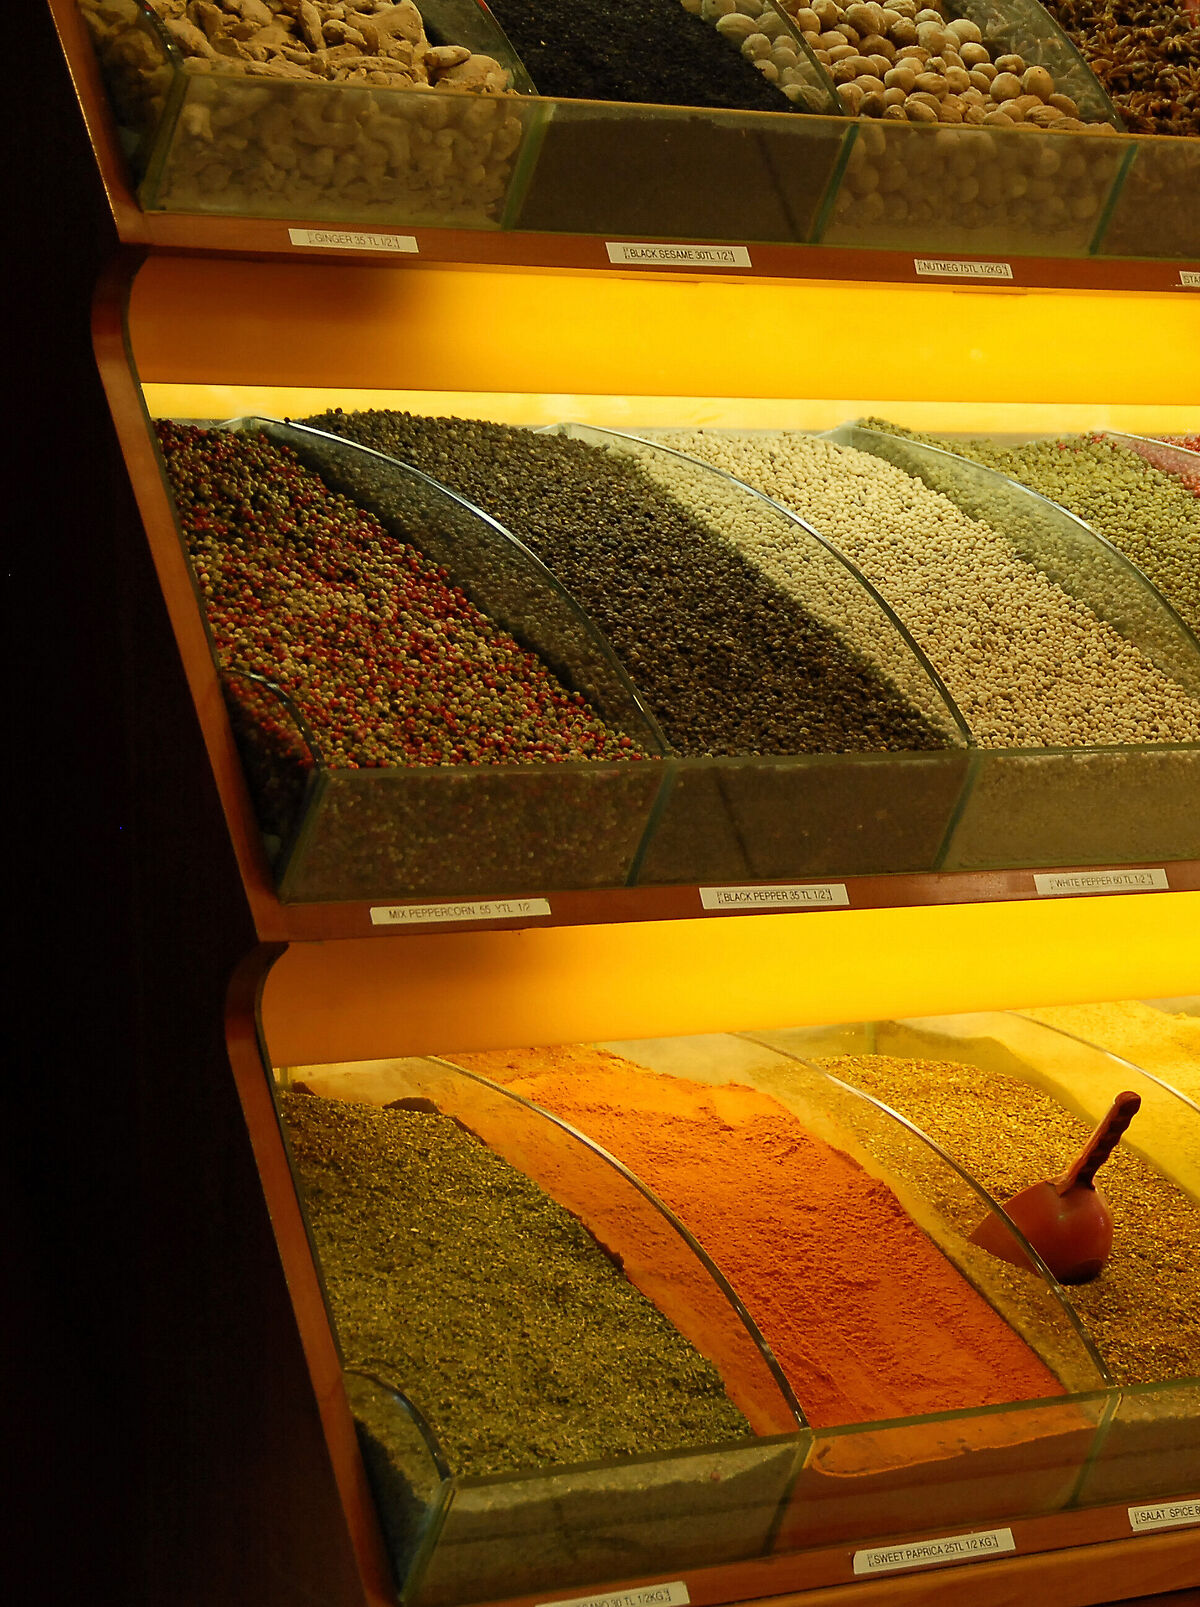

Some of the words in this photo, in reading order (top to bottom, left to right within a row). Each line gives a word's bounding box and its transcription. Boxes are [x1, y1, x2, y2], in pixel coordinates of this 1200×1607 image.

[314, 233, 352, 244] GINGER
[355, 236, 366, 245] 35
[368, 236, 379, 246] TL
[381, 237, 393, 247] 1/2
[630, 248, 657, 259] BLACK
[659, 249, 694, 260] SESAME
[716, 251, 728, 261] 1/2
[923, 262, 958, 272] NUTMEG
[960, 264, 978, 273] 75TL
[979, 265, 1002, 274] 1/2KG
[1055, 877, 1080, 888] WHITE
[1081, 875, 1112, 887] PEPPER
[1123, 875, 1134, 884] TL
[1134, 874, 1145, 884] 1/2
[723, 891, 752, 902] BLACK
[753, 890, 788, 901] PEPPER
[789, 890, 800, 900] 35
[801, 889, 812, 899] TL
[814, 889, 826, 899] 1/2
[388, 909, 407, 919] MIX
[408, 905, 475, 918] PEPPERCORN
[494, 903, 513, 913] YTL
[518, 902, 530, 912] 1/2
[1140, 1510, 1166, 1521] SALAT
[1169, 1506, 1193, 1518] SPICE
[874, 1551, 904, 1565] SWEET
[906, 1545, 943, 1559] PAPRICA
[944, 1542, 965, 1553] 25TL
[966, 1539, 977, 1550] 1/2
[978, 1537, 992, 1548] KG
[624, 1597, 635, 1607] TL
[637, 1591, 664, 1604] 1/2KG
